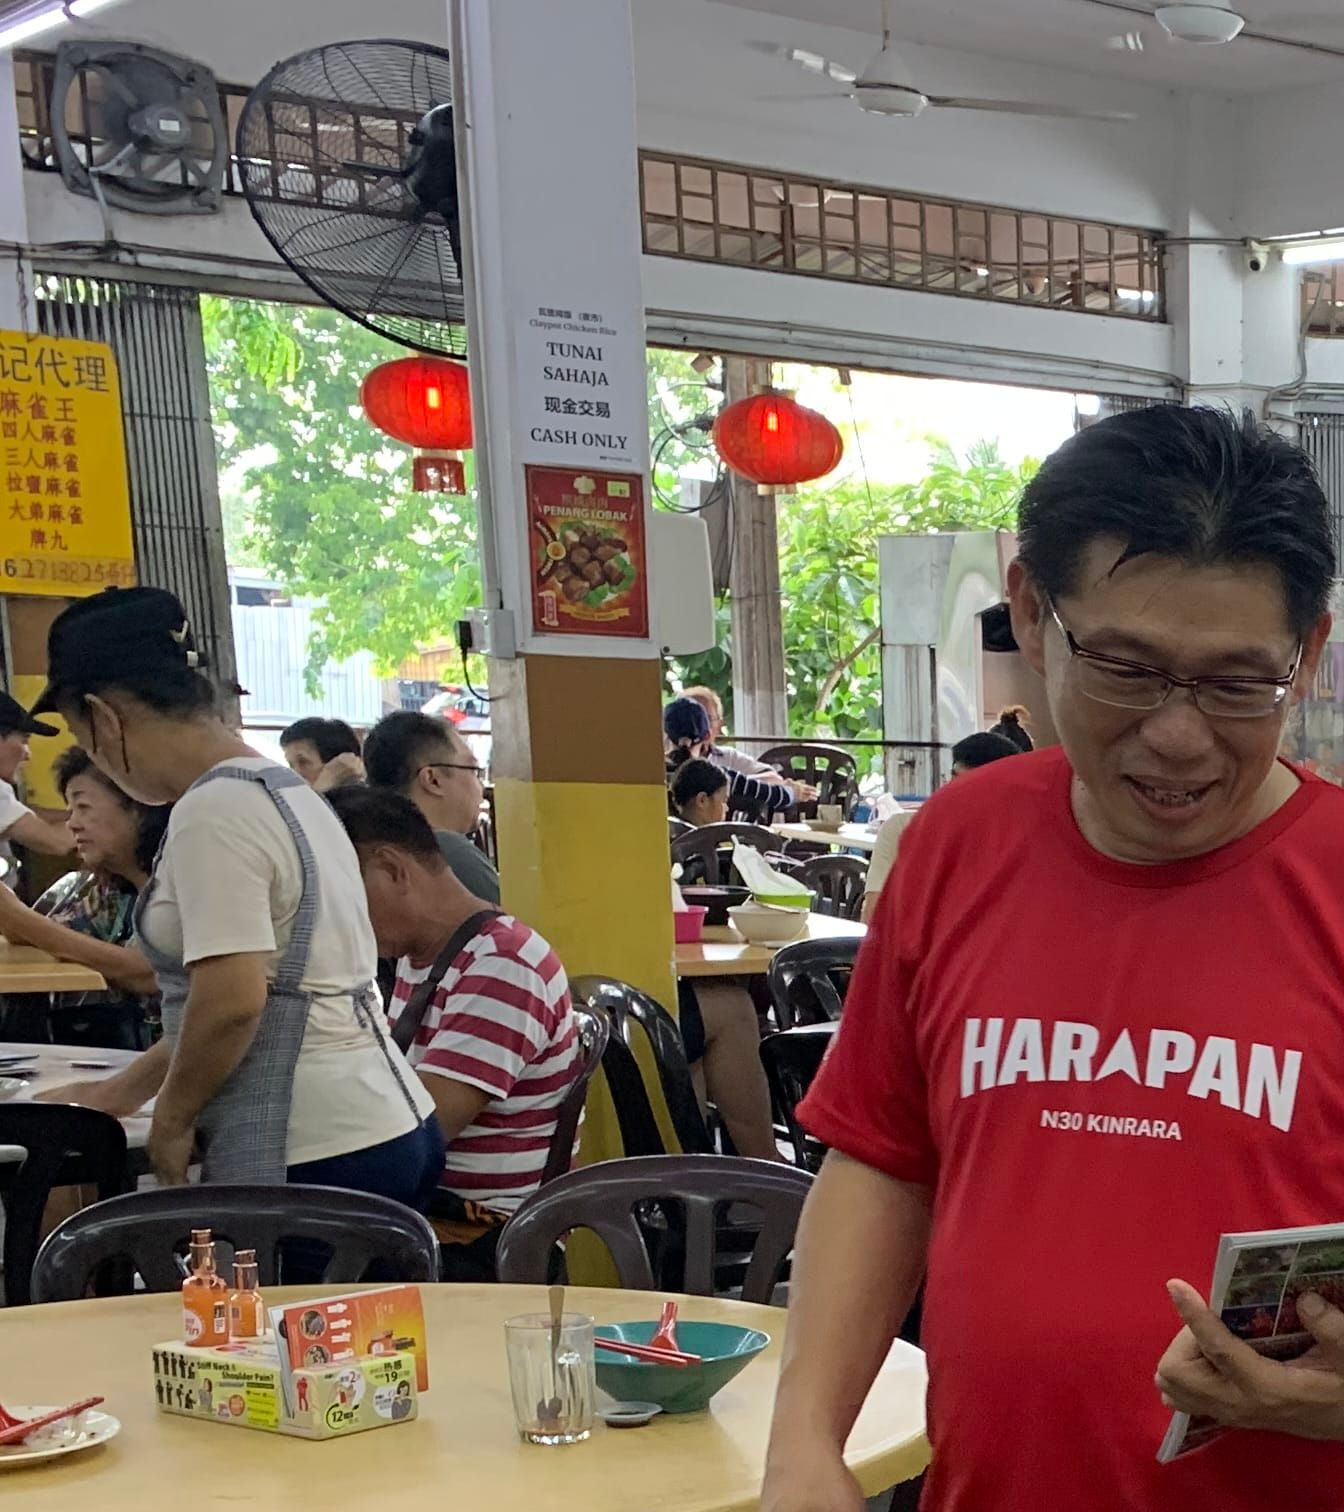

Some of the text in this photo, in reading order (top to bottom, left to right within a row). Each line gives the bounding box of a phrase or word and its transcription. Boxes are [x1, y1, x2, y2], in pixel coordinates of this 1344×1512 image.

[546, 341, 603, 362] TUNAI
[543, 366, 609, 388] SAHAJA
[544, 396, 611, 419] 现金交易
[530, 427, 628, 450] CASH ONLY
[543, 505, 630, 522] PENANG LOBAK
[961, 1017, 1303, 1133] HARAPAN
[1040, 1109, 1182, 1141] N30 KINRARA
[196, 1361, 212, 1370] Stiff
[213, 1362, 231, 1371] Neck
[222, 1370, 254, 1382] Shoulder
[384, 1371, 398, 1383] 19
[332, 1411, 343, 1423] 12
